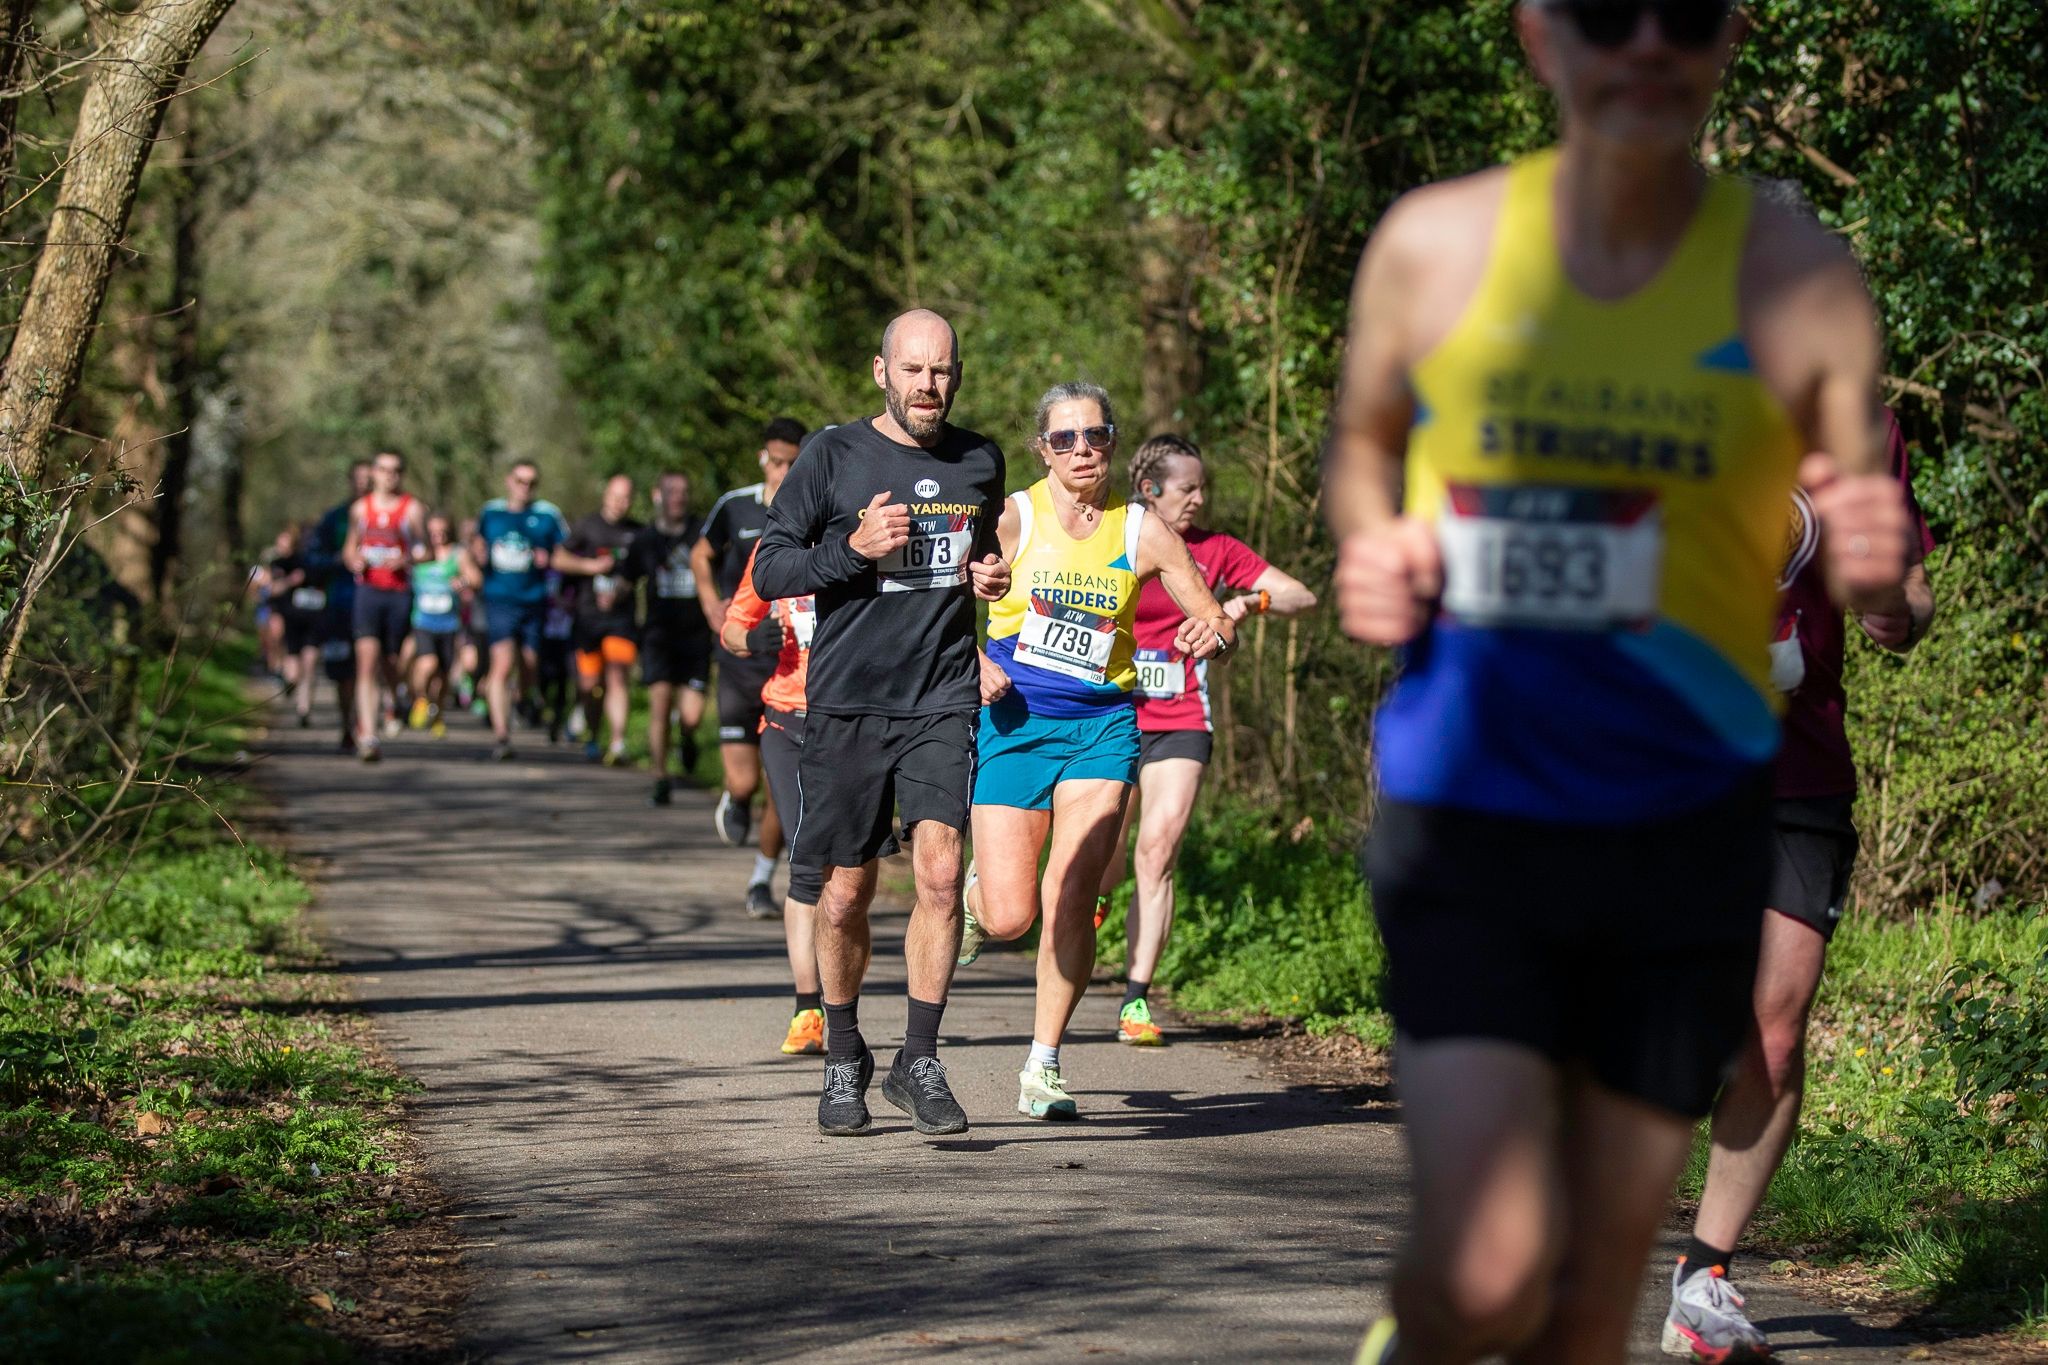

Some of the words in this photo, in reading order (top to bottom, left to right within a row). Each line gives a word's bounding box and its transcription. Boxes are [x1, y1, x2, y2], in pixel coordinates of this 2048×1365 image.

[1480, 418, 1715, 479] STRIDERS
[919, 484, 936, 493] ATW
[911, 502, 982, 517] YARMOUTH
[917, 520, 937, 532] ATW
[903, 537, 951, 568] 1673
[1032, 570, 1049, 584] ST
[1056, 572, 1118, 592] ALBANS
[1031, 588, 1118, 610] STRIDERS
[1064, 609, 1085, 623] ATW
[1043, 621, 1092, 657] 1739
[1138, 650, 1157, 660] ATW
